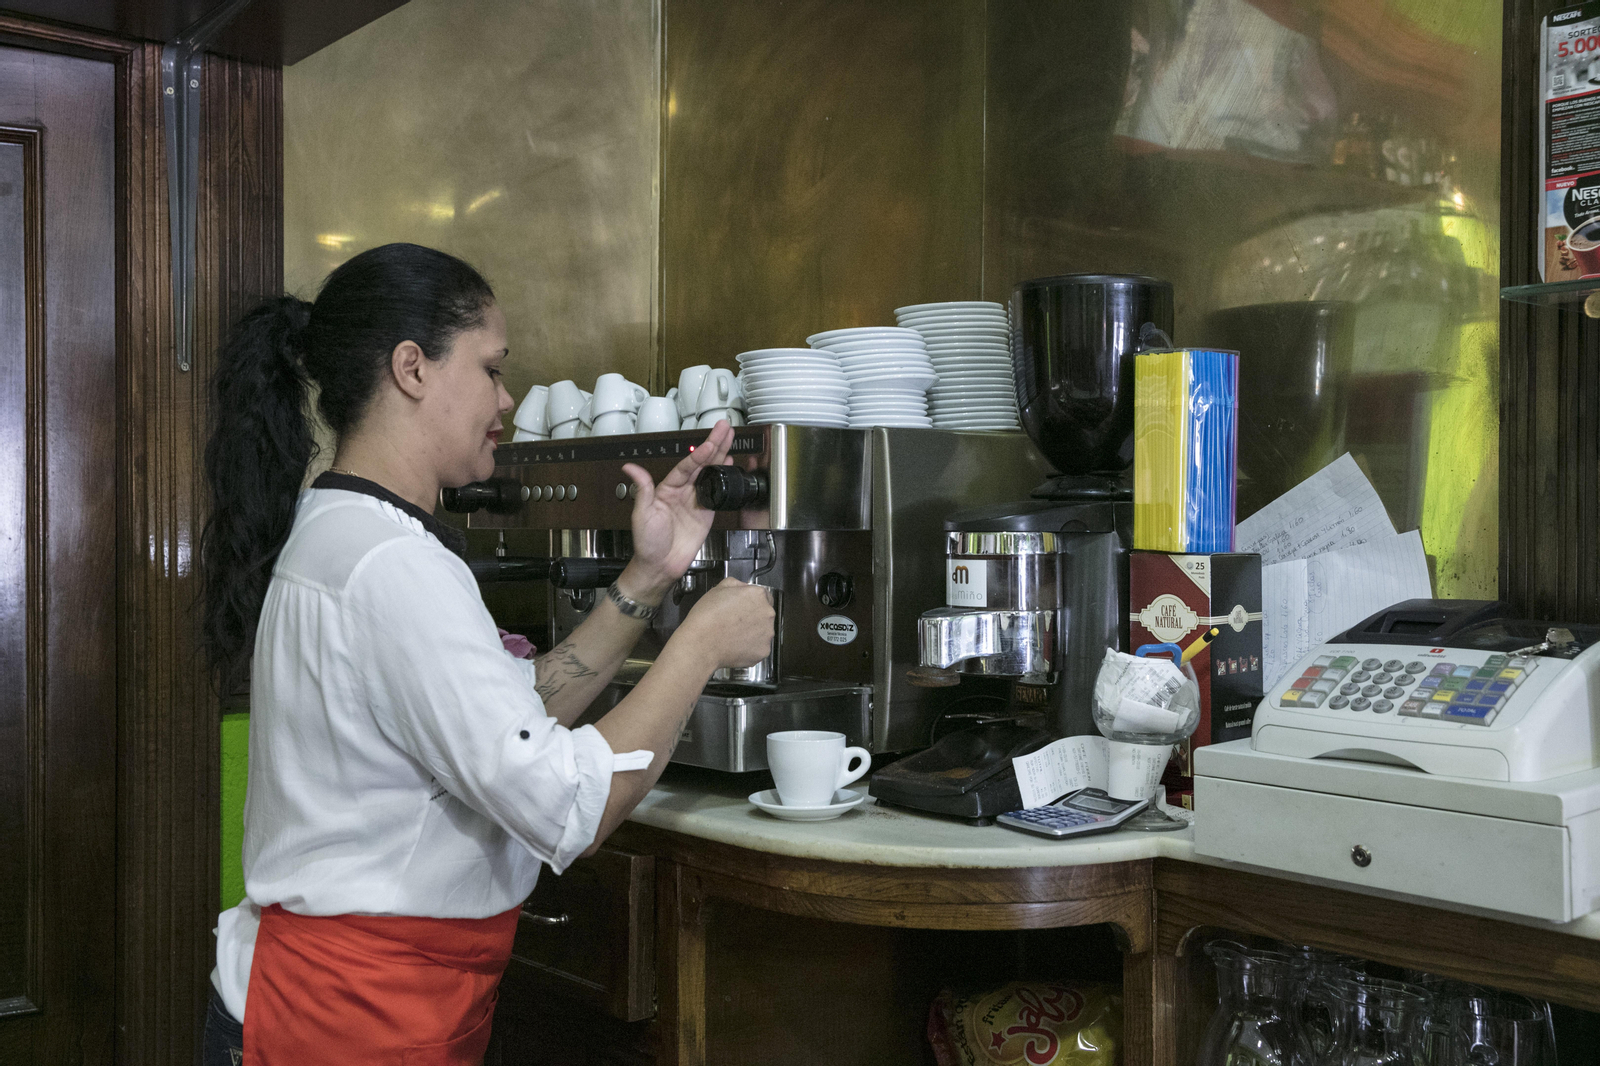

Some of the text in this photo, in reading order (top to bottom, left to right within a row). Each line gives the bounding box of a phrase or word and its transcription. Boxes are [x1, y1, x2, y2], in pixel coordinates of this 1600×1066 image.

[1558, 36, 1600, 57] 5.00
[1572, 186, 1600, 202] NES
[1196, 562, 1204, 570] 25
[1161, 604, 1176, 616] CAFÉ
[1155, 616, 1183, 629] NATURAL
